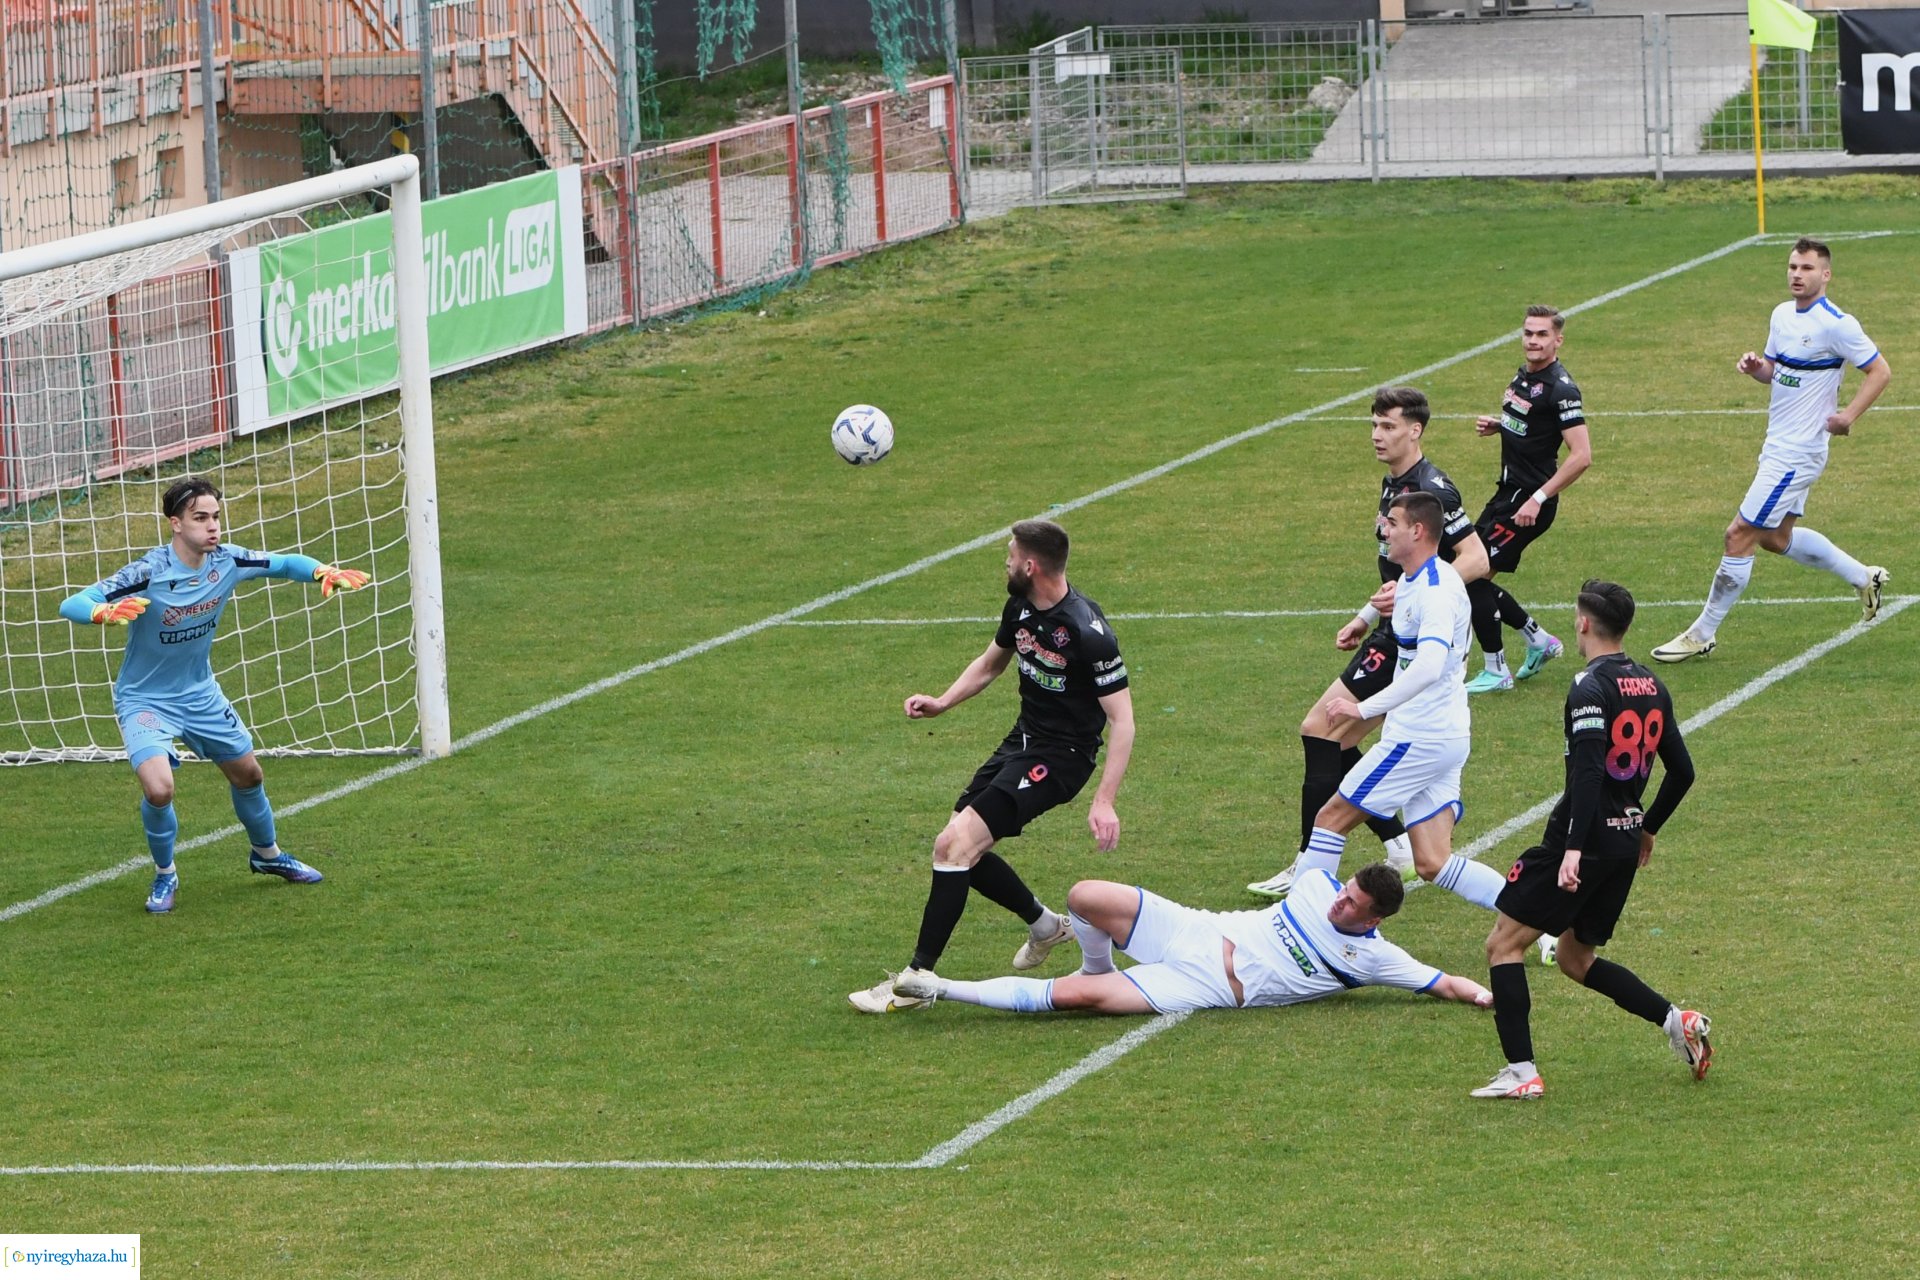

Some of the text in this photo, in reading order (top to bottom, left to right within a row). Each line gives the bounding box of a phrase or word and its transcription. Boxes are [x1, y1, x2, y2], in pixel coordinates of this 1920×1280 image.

[509, 221, 551, 275] LIGA
[1488, 523, 1516, 547] 77
[1361, 648, 1386, 672] 15
[1606, 709, 1664, 781] 88
[1028, 764, 1048, 782] 9
